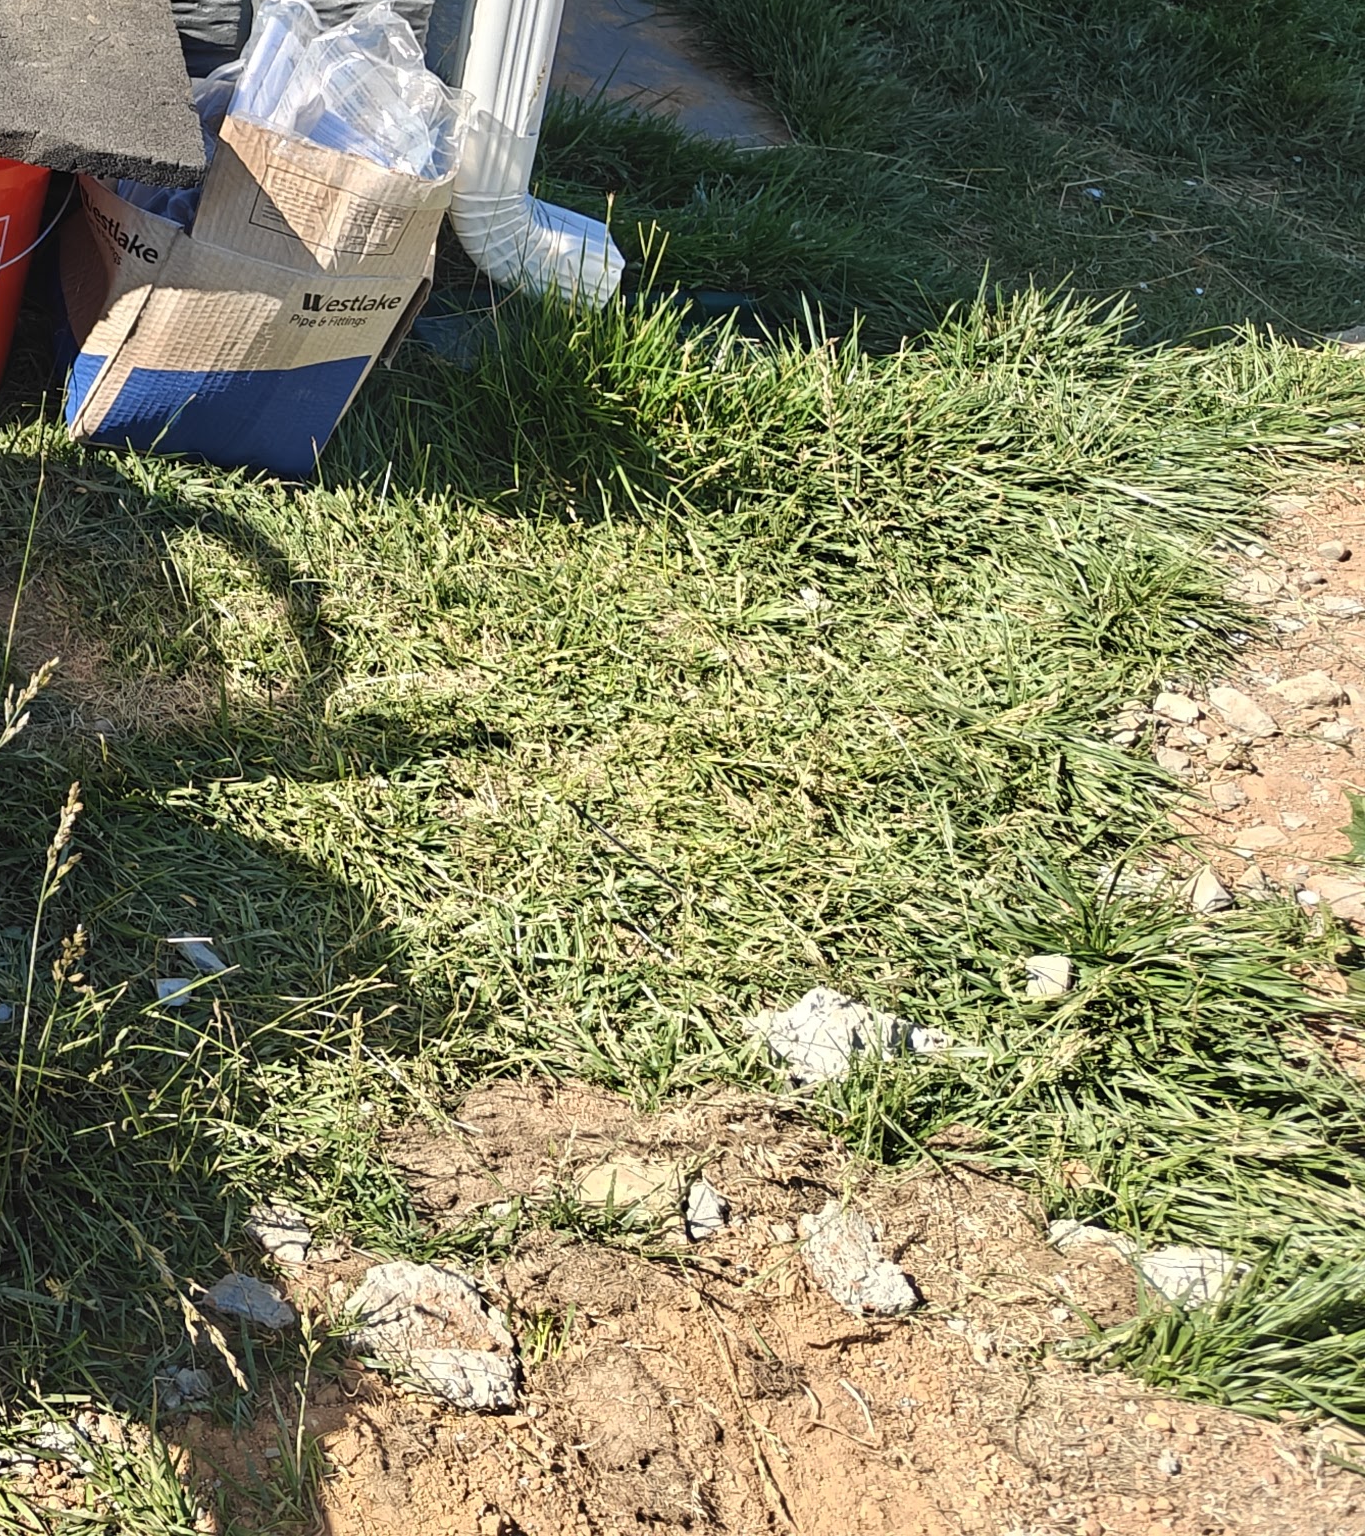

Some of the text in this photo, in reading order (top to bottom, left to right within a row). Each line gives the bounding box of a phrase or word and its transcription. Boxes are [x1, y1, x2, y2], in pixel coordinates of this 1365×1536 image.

[302, 292, 401, 312] Westlake
[289, 314, 367, 327] Pipe & Fittings
